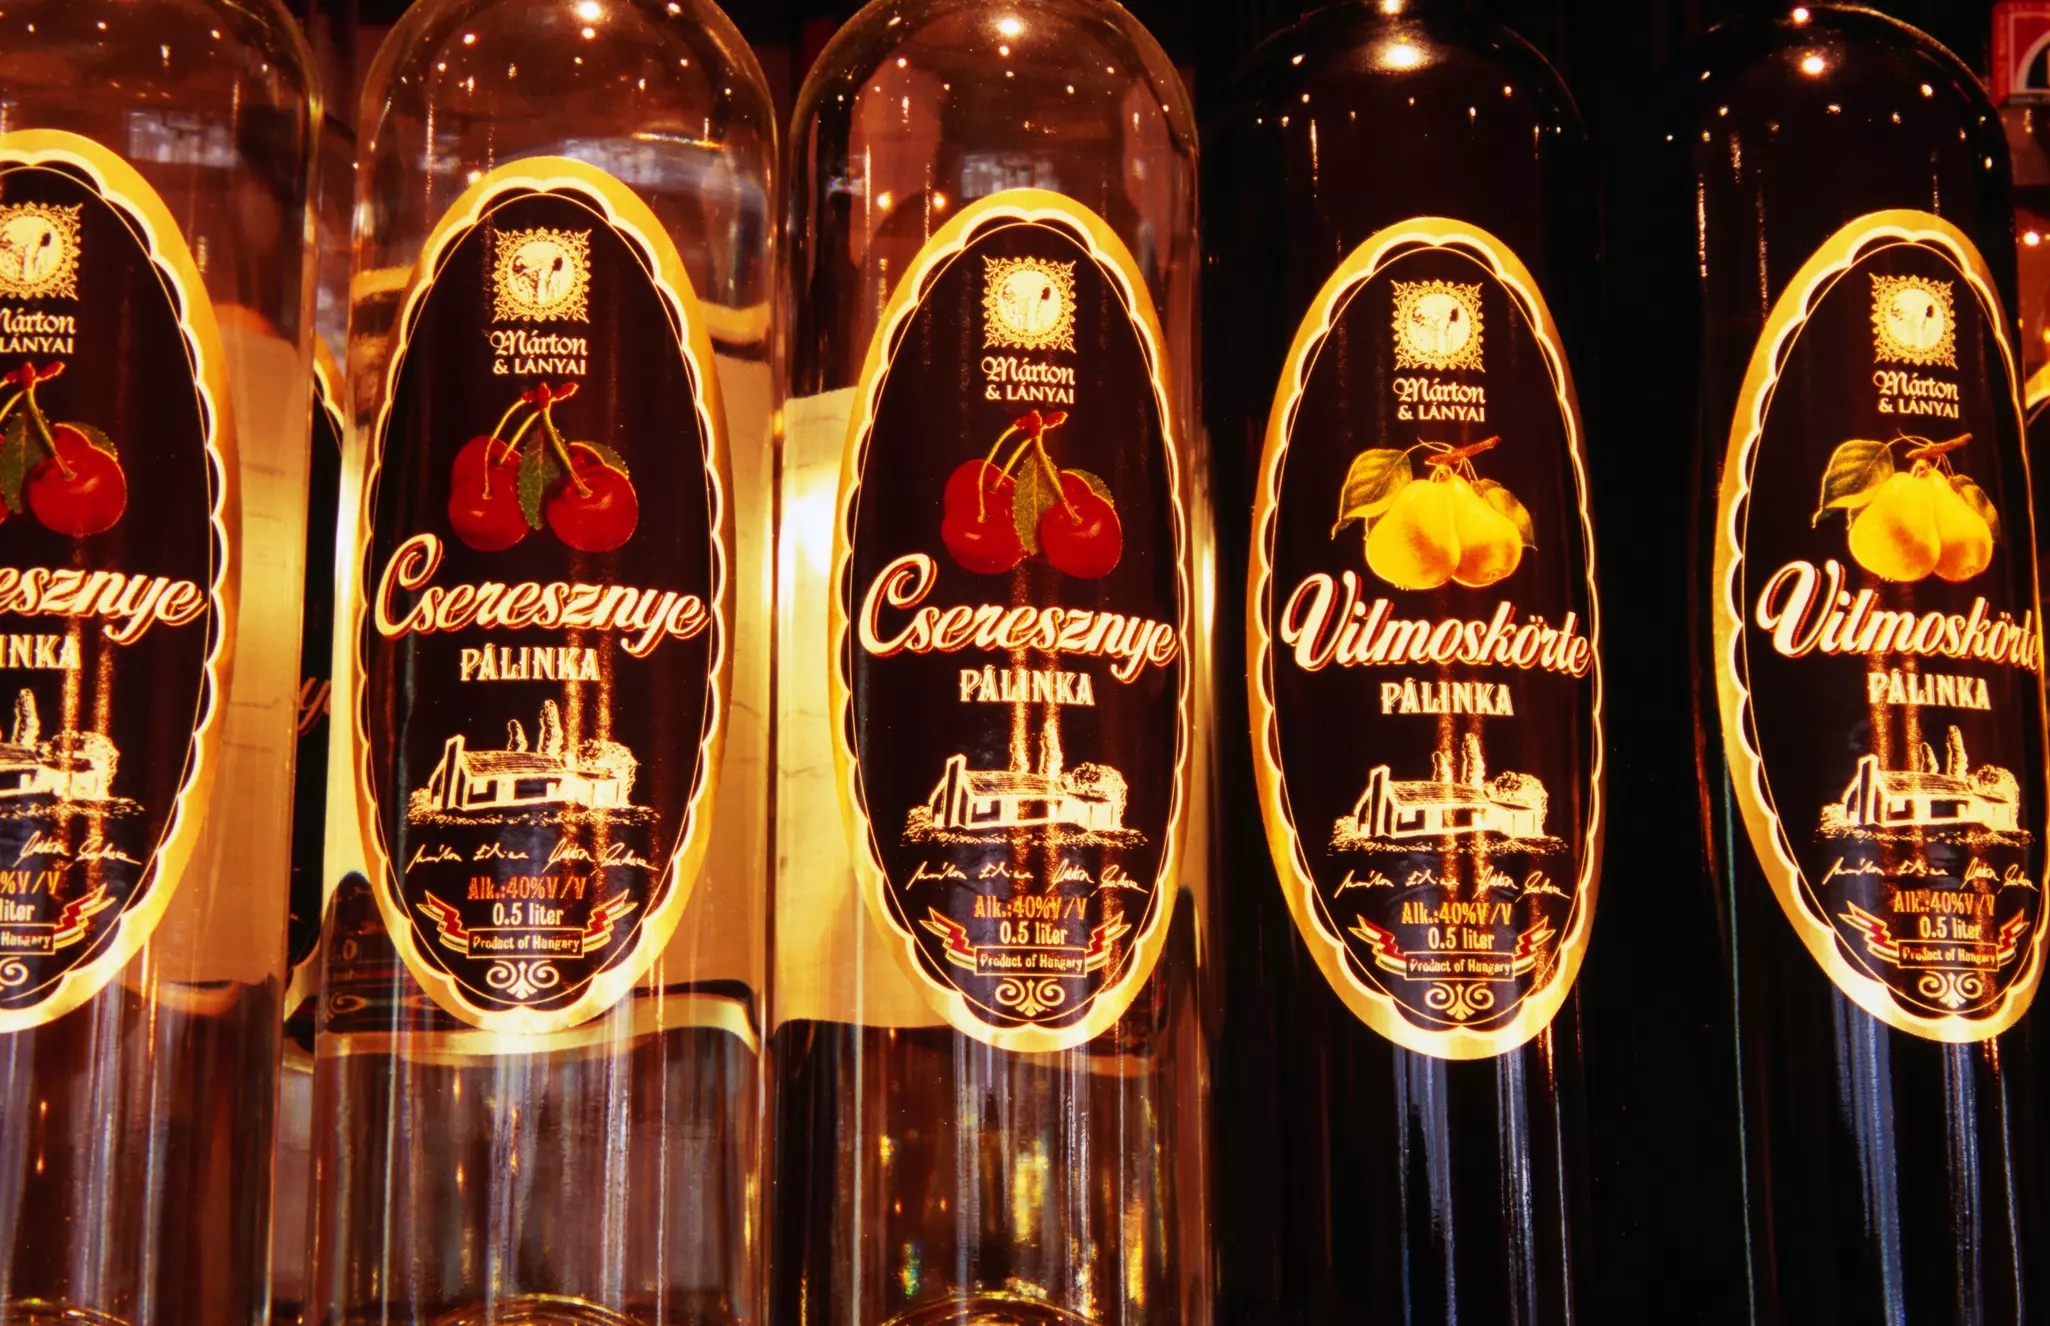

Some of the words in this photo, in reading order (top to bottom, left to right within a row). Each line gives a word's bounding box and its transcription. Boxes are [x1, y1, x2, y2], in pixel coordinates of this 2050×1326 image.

[490, 330, 588, 356] Márton
[492, 359, 509, 375] &
[514, 357, 586, 376] LÁNYAI
[981, 356, 1076, 384] Márton
[985, 384, 1002, 400] &
[1006, 381, 1075, 404] LÁNYAI
[1393, 377, 1485, 404] Márton
[1872, 370, 1959, 400] Márton
[1398, 404, 1414, 420] &
[1418, 401, 1485, 422] LÁNYAI
[1878, 398, 1894, 413] &
[1898, 395, 1959, 419] LÁNYAI
[375, 533, 710, 658] Cseresznye
[858, 553, 1179, 684] Cseresznye
[1280, 570, 1592, 679] Vilmoskörte
[460, 643, 601, 681] PÁLINKA
[959, 664, 1095, 707] PÁLINKA
[1381, 678, 1514, 716] PÁLINKA
[1867, 667, 1991, 711] PÁLINKA
[493, 903, 522, 926] 0.5
[529, 902, 564, 926] liter
[1000, 921, 1029, 944] 0.5
[1036, 922, 1068, 946] liter
[1428, 927, 1456, 950] 0.5
[1462, 927, 1495, 950] liter
[1920, 916, 1947, 939] 0.5
[1953, 917, 1982, 940] liter
[473, 936, 514, 950] Product
[518, 936, 530, 950] of
[533, 936, 580, 953] Hungary
[1902, 946, 1942, 962] Product
[1945, 947, 1956, 962] of
[1958, 948, 1997, 966] Hungary
[980, 953, 1022, 968] Product
[1025, 953, 1037, 968] of
[1040, 954, 1083, 971] Hungary
[1409, 957, 1451, 972] Product
[1454, 958, 1466, 972] of
[1468, 959, 1511, 976] Hungary
